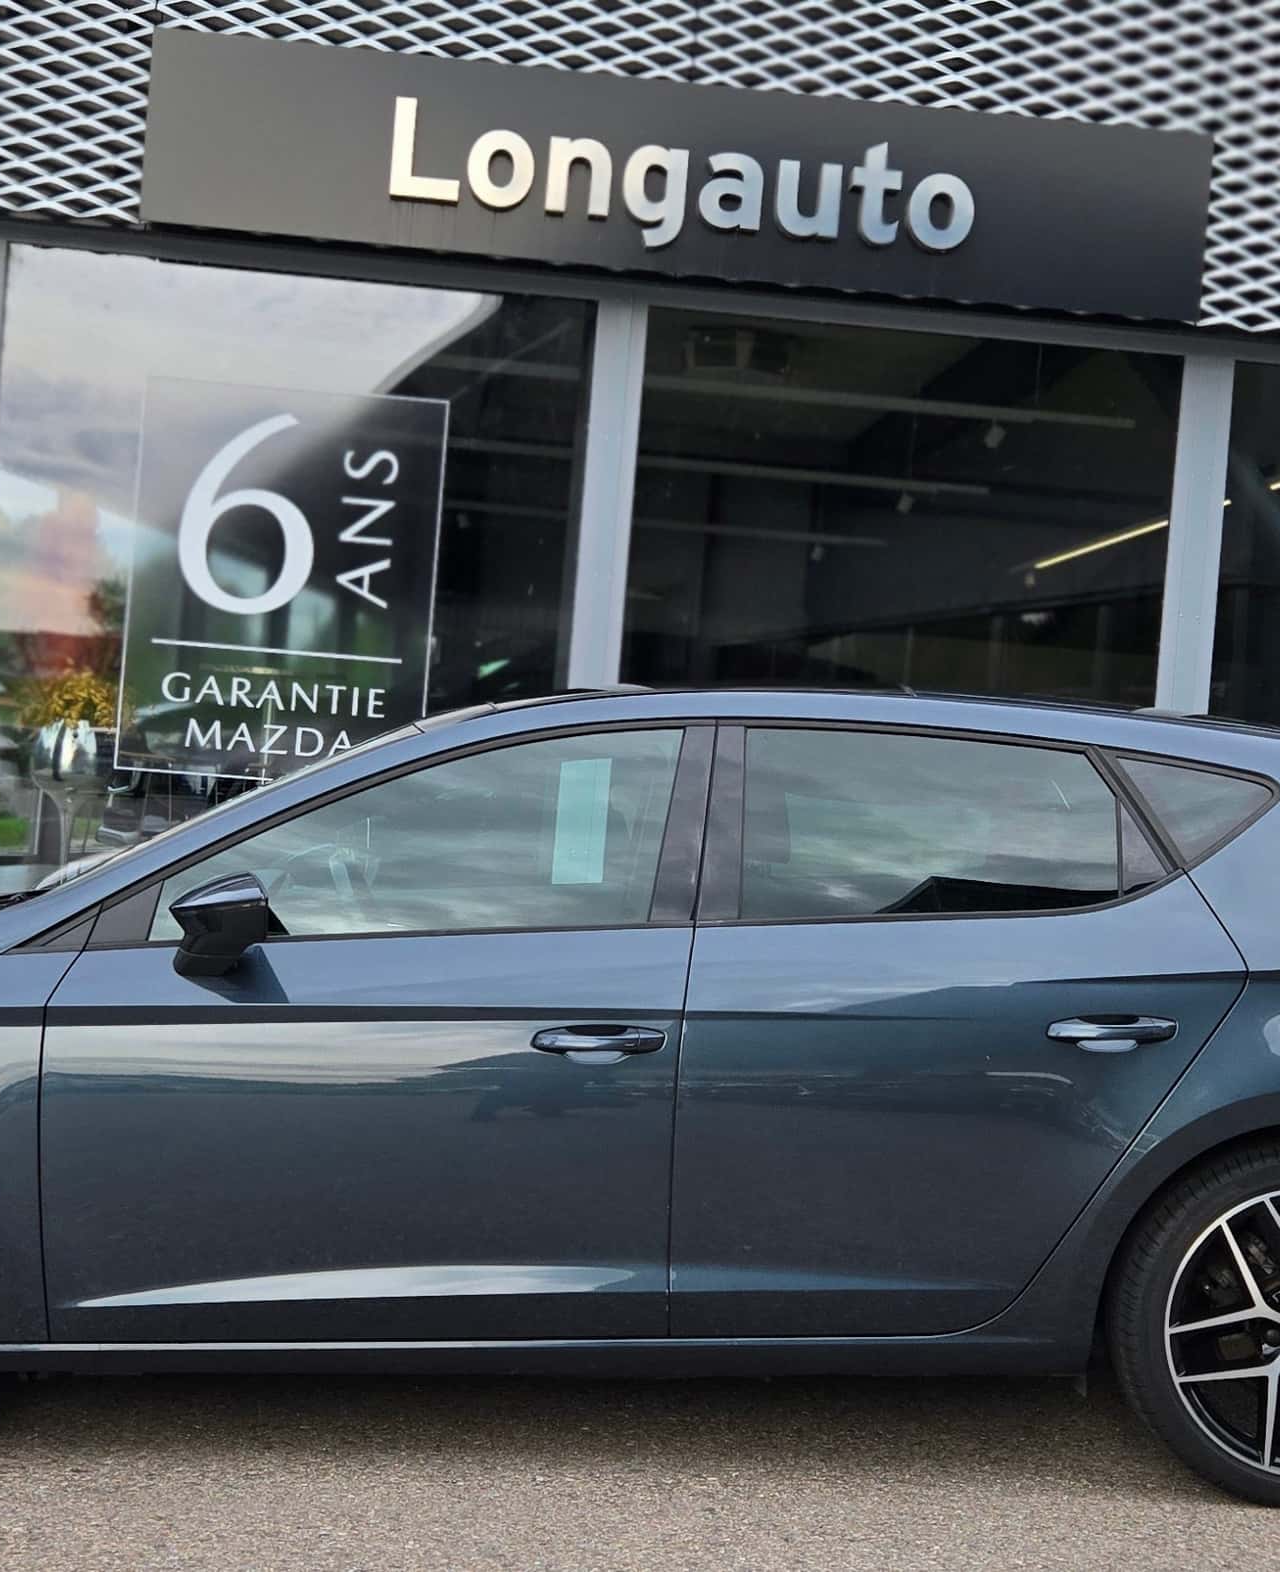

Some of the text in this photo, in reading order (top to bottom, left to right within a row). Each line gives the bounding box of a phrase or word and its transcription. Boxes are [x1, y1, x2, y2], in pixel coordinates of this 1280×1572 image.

[388, 96, 976, 251] Longauto
[178, 413, 315, 615] 6
[336, 449, 400, 609] ANS
[161, 671, 386, 718] GARANTIE
[184, 718, 353, 758] MAZDA
